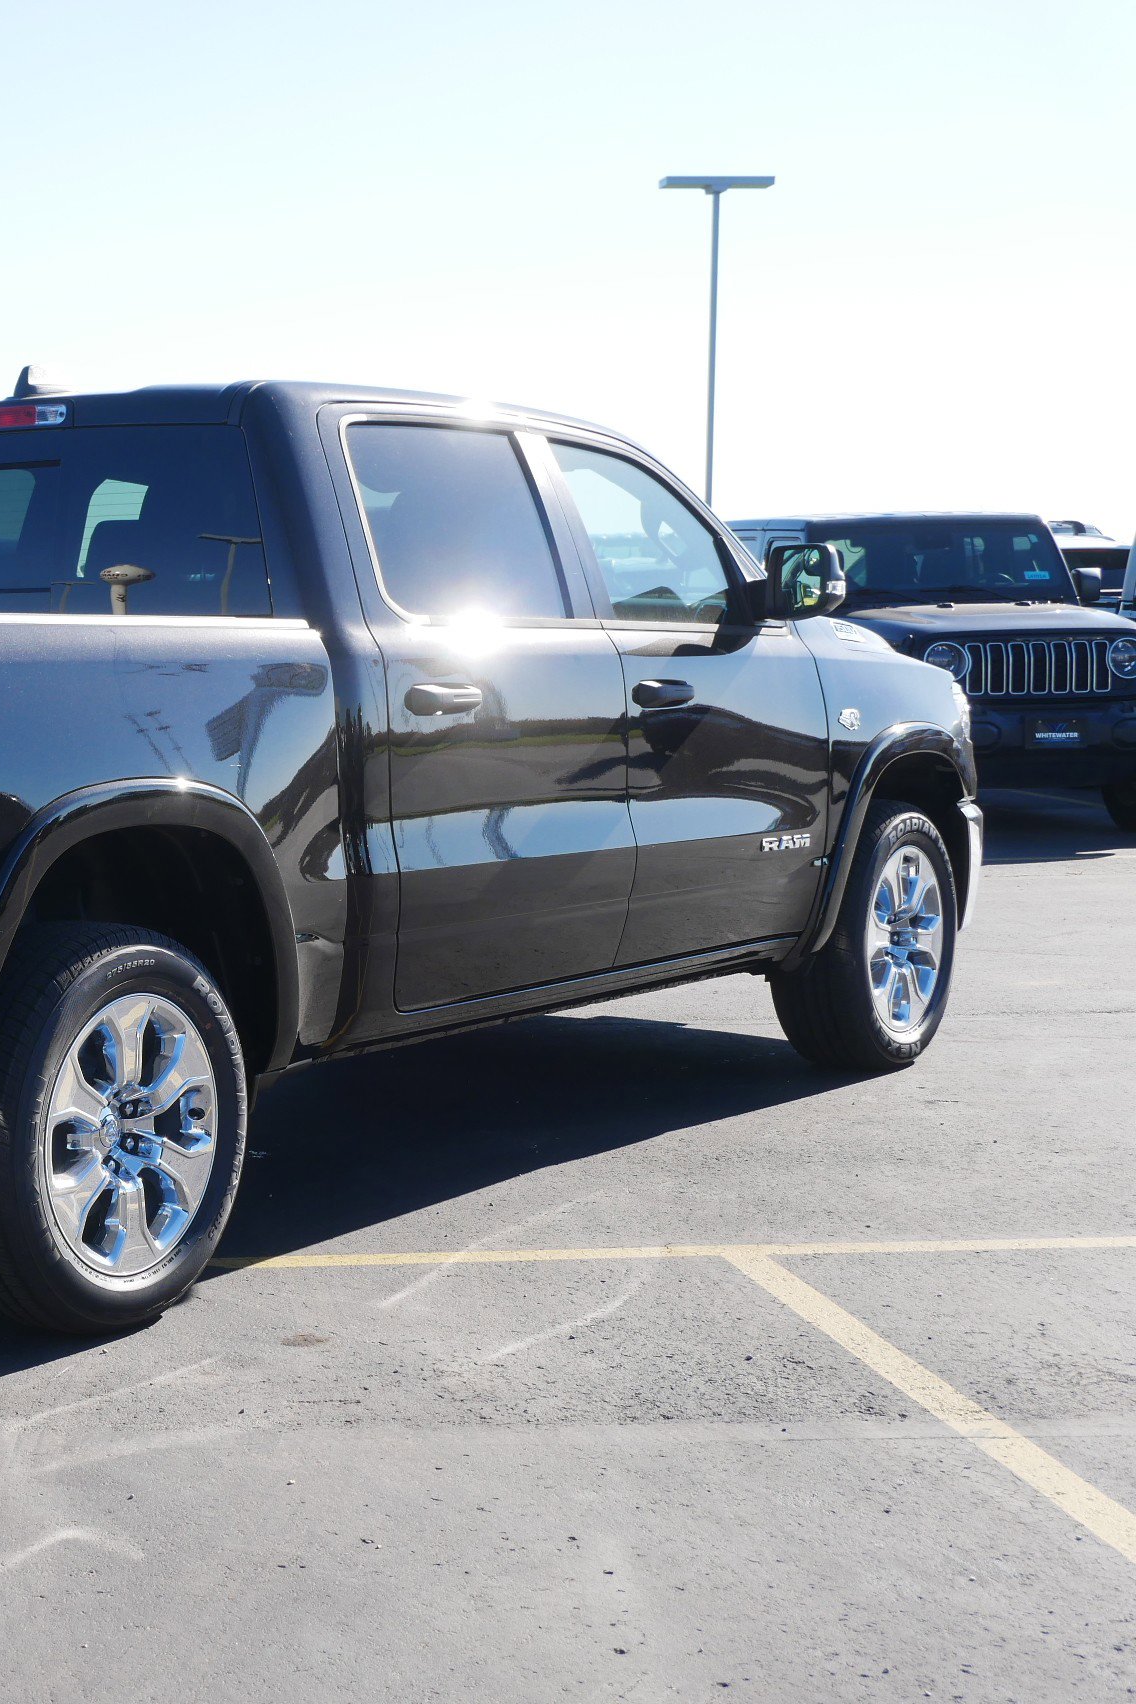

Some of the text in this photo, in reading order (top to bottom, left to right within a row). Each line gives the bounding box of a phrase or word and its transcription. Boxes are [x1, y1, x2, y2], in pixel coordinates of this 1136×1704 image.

[760, 833, 811, 852] RAM
[889, 818, 937, 847] ROADIAN
[192, 975, 247, 1115] ROADIAN
